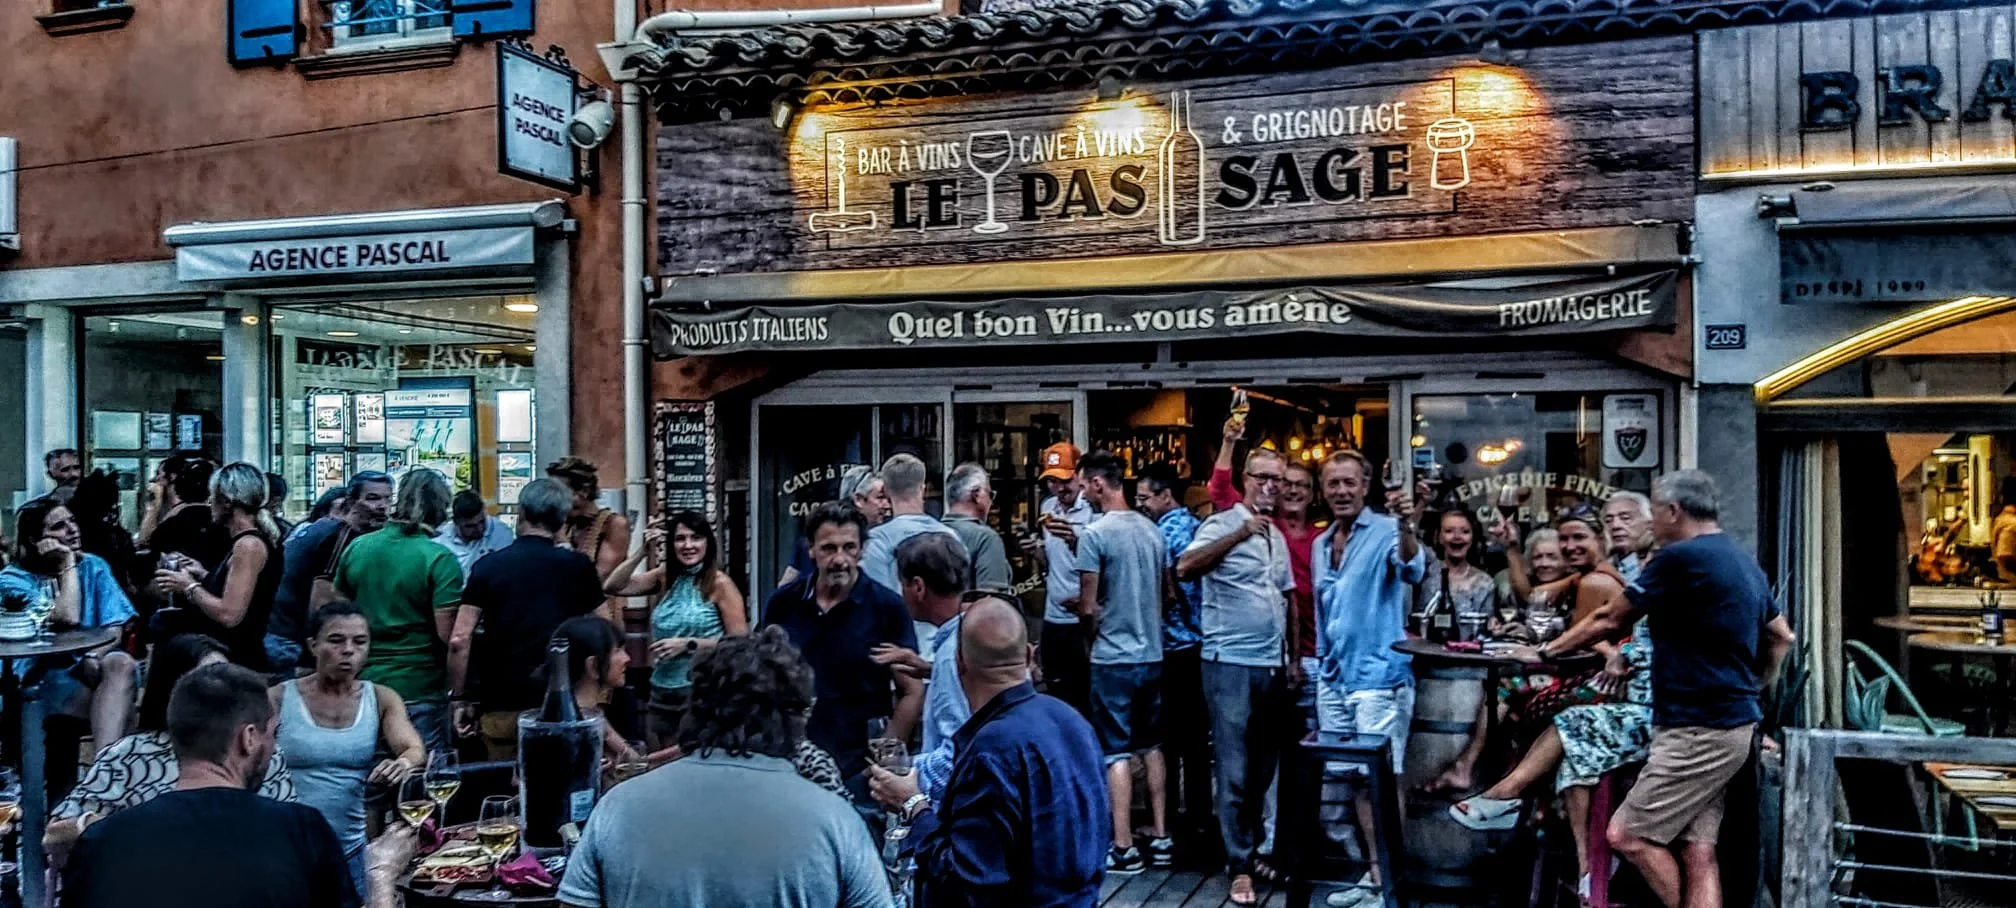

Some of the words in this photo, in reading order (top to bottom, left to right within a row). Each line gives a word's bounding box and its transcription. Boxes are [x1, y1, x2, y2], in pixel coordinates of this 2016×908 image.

[513, 92, 565, 124] AGENCE
[1222, 116, 1242, 144] &
[1252, 102, 1408, 143] GRIGNOTAGE
[515, 117, 564, 146] PASCAL
[1018, 135, 1069, 162] CAVE
[1075, 125, 1087, 159] À
[1094, 126, 1146, 157] VINS
[858, 146, 891, 175] BAR
[898, 140, 911, 172] À
[916, 142, 962, 171] VINS
[890, 177, 962, 233] LE
[1018, 164, 1148, 222] PAS
[1214, 143, 1412, 211] SAGE
[249, 246, 348, 272] AGENCE
[355, 240, 450, 266] PASCAL
[888, 312, 964, 345] Quel
[974, 310, 1037, 336] bon
[1224, 294, 1352, 327] amène
[1500, 289, 1653, 326] FROMAGERIE
[671, 319, 748, 346] PRODUITS
[752, 316, 828, 342] ITALIENS
[1711, 329, 1741, 345] 209
[783, 467, 822, 494] CAVE
[826, 464, 836, 479] à
[1455, 471, 1557, 502] EPICERIE
[1564, 474, 1614, 502] FINE
[1477, 505, 1530, 522] CAE
